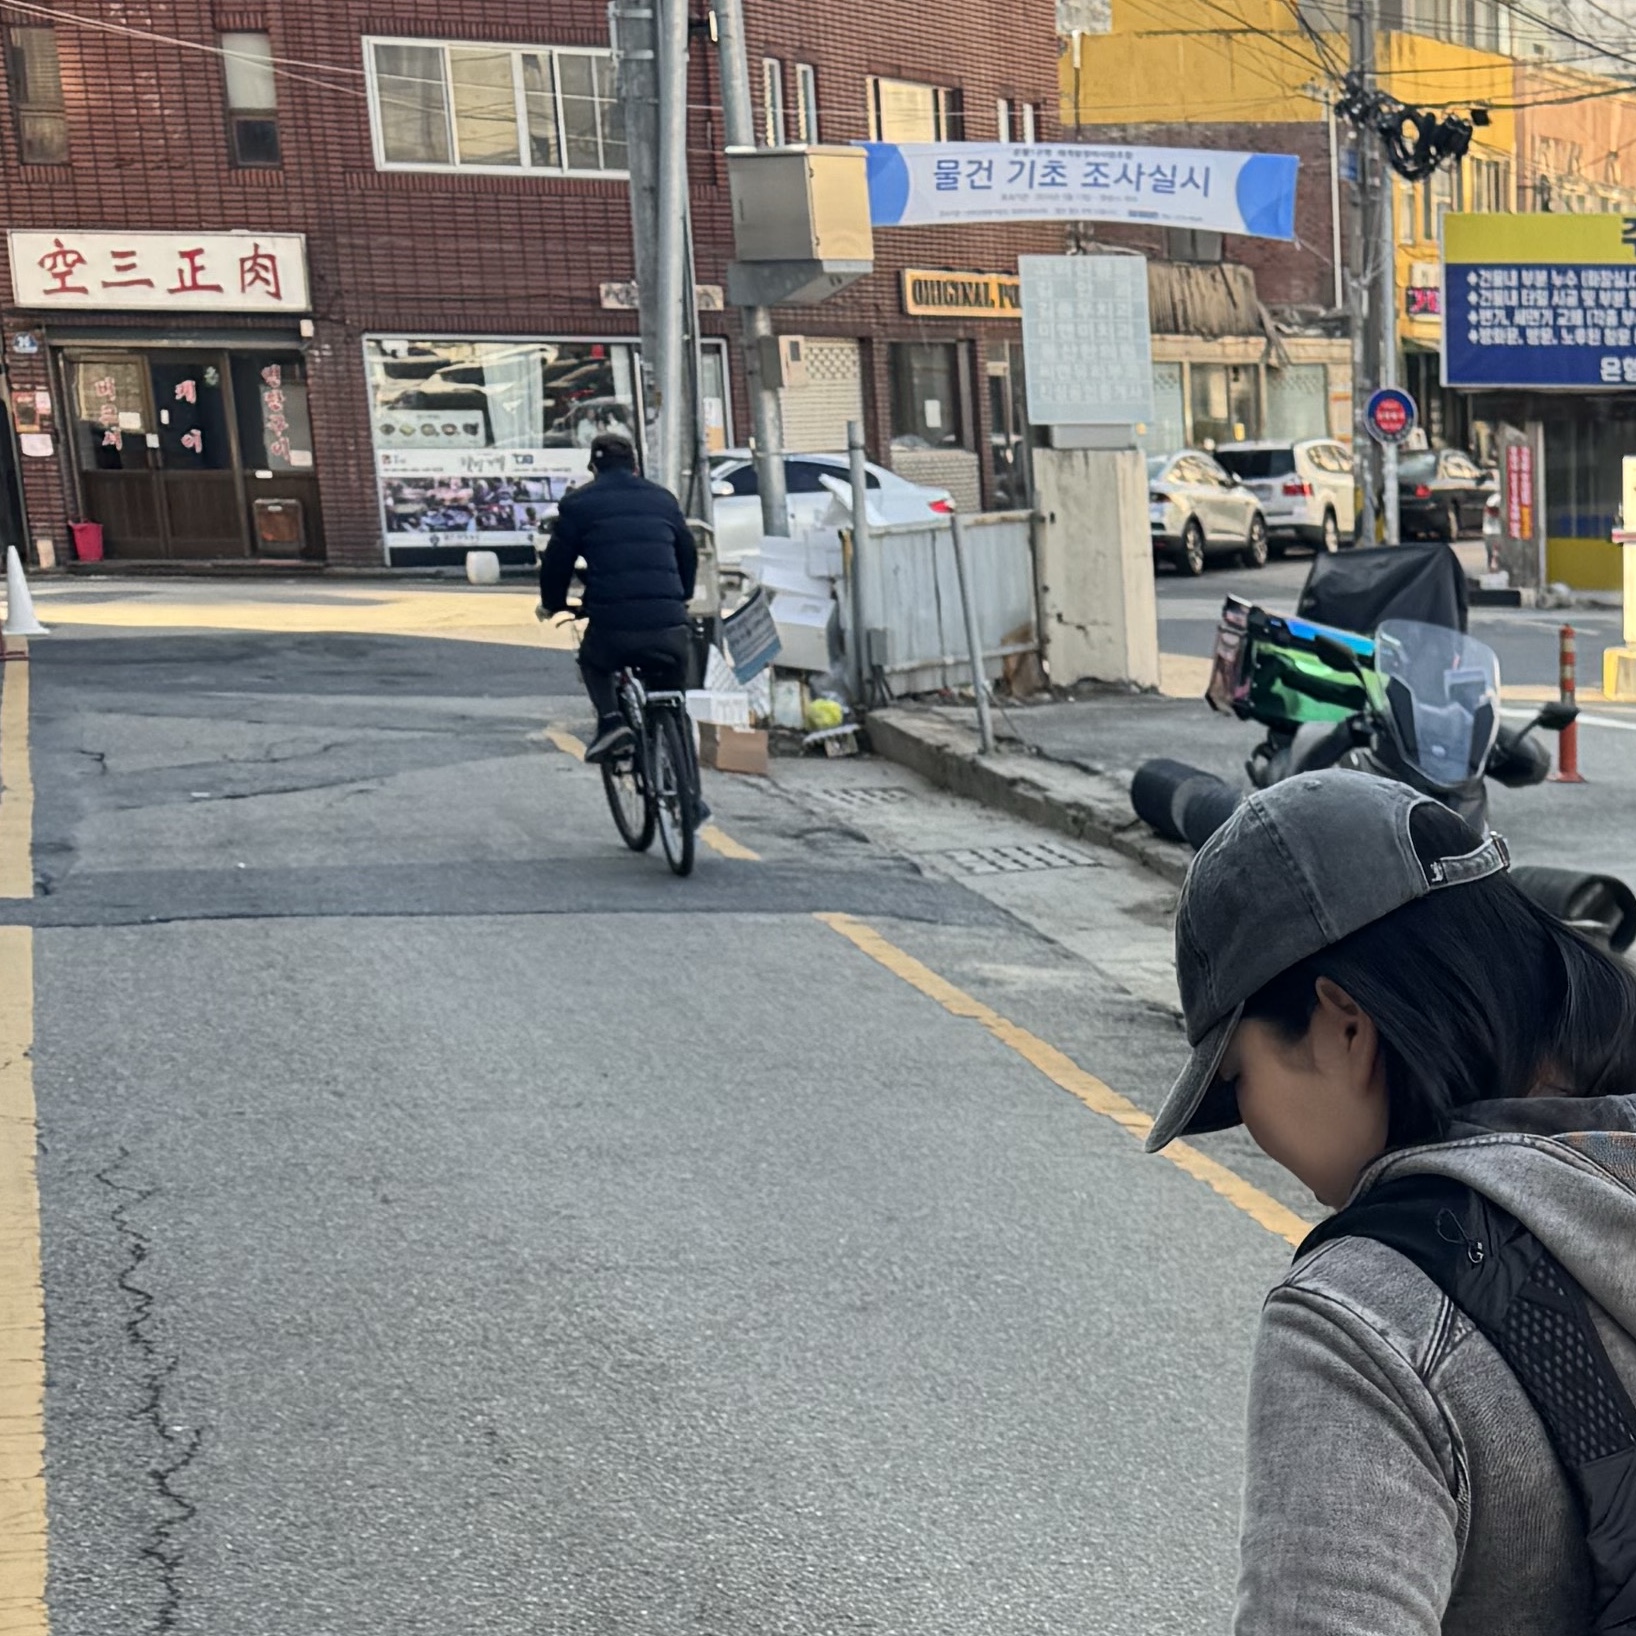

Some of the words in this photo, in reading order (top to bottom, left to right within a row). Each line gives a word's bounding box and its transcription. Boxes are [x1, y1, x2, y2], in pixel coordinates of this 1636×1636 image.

[933, 158, 994, 191] 물건
[1007, 159, 1069, 190] 기초
[1080, 161, 1211, 198] 조사실시
[37, 238, 283, 301] 空三正肉
[911, 278, 995, 308] ORIGINAL
